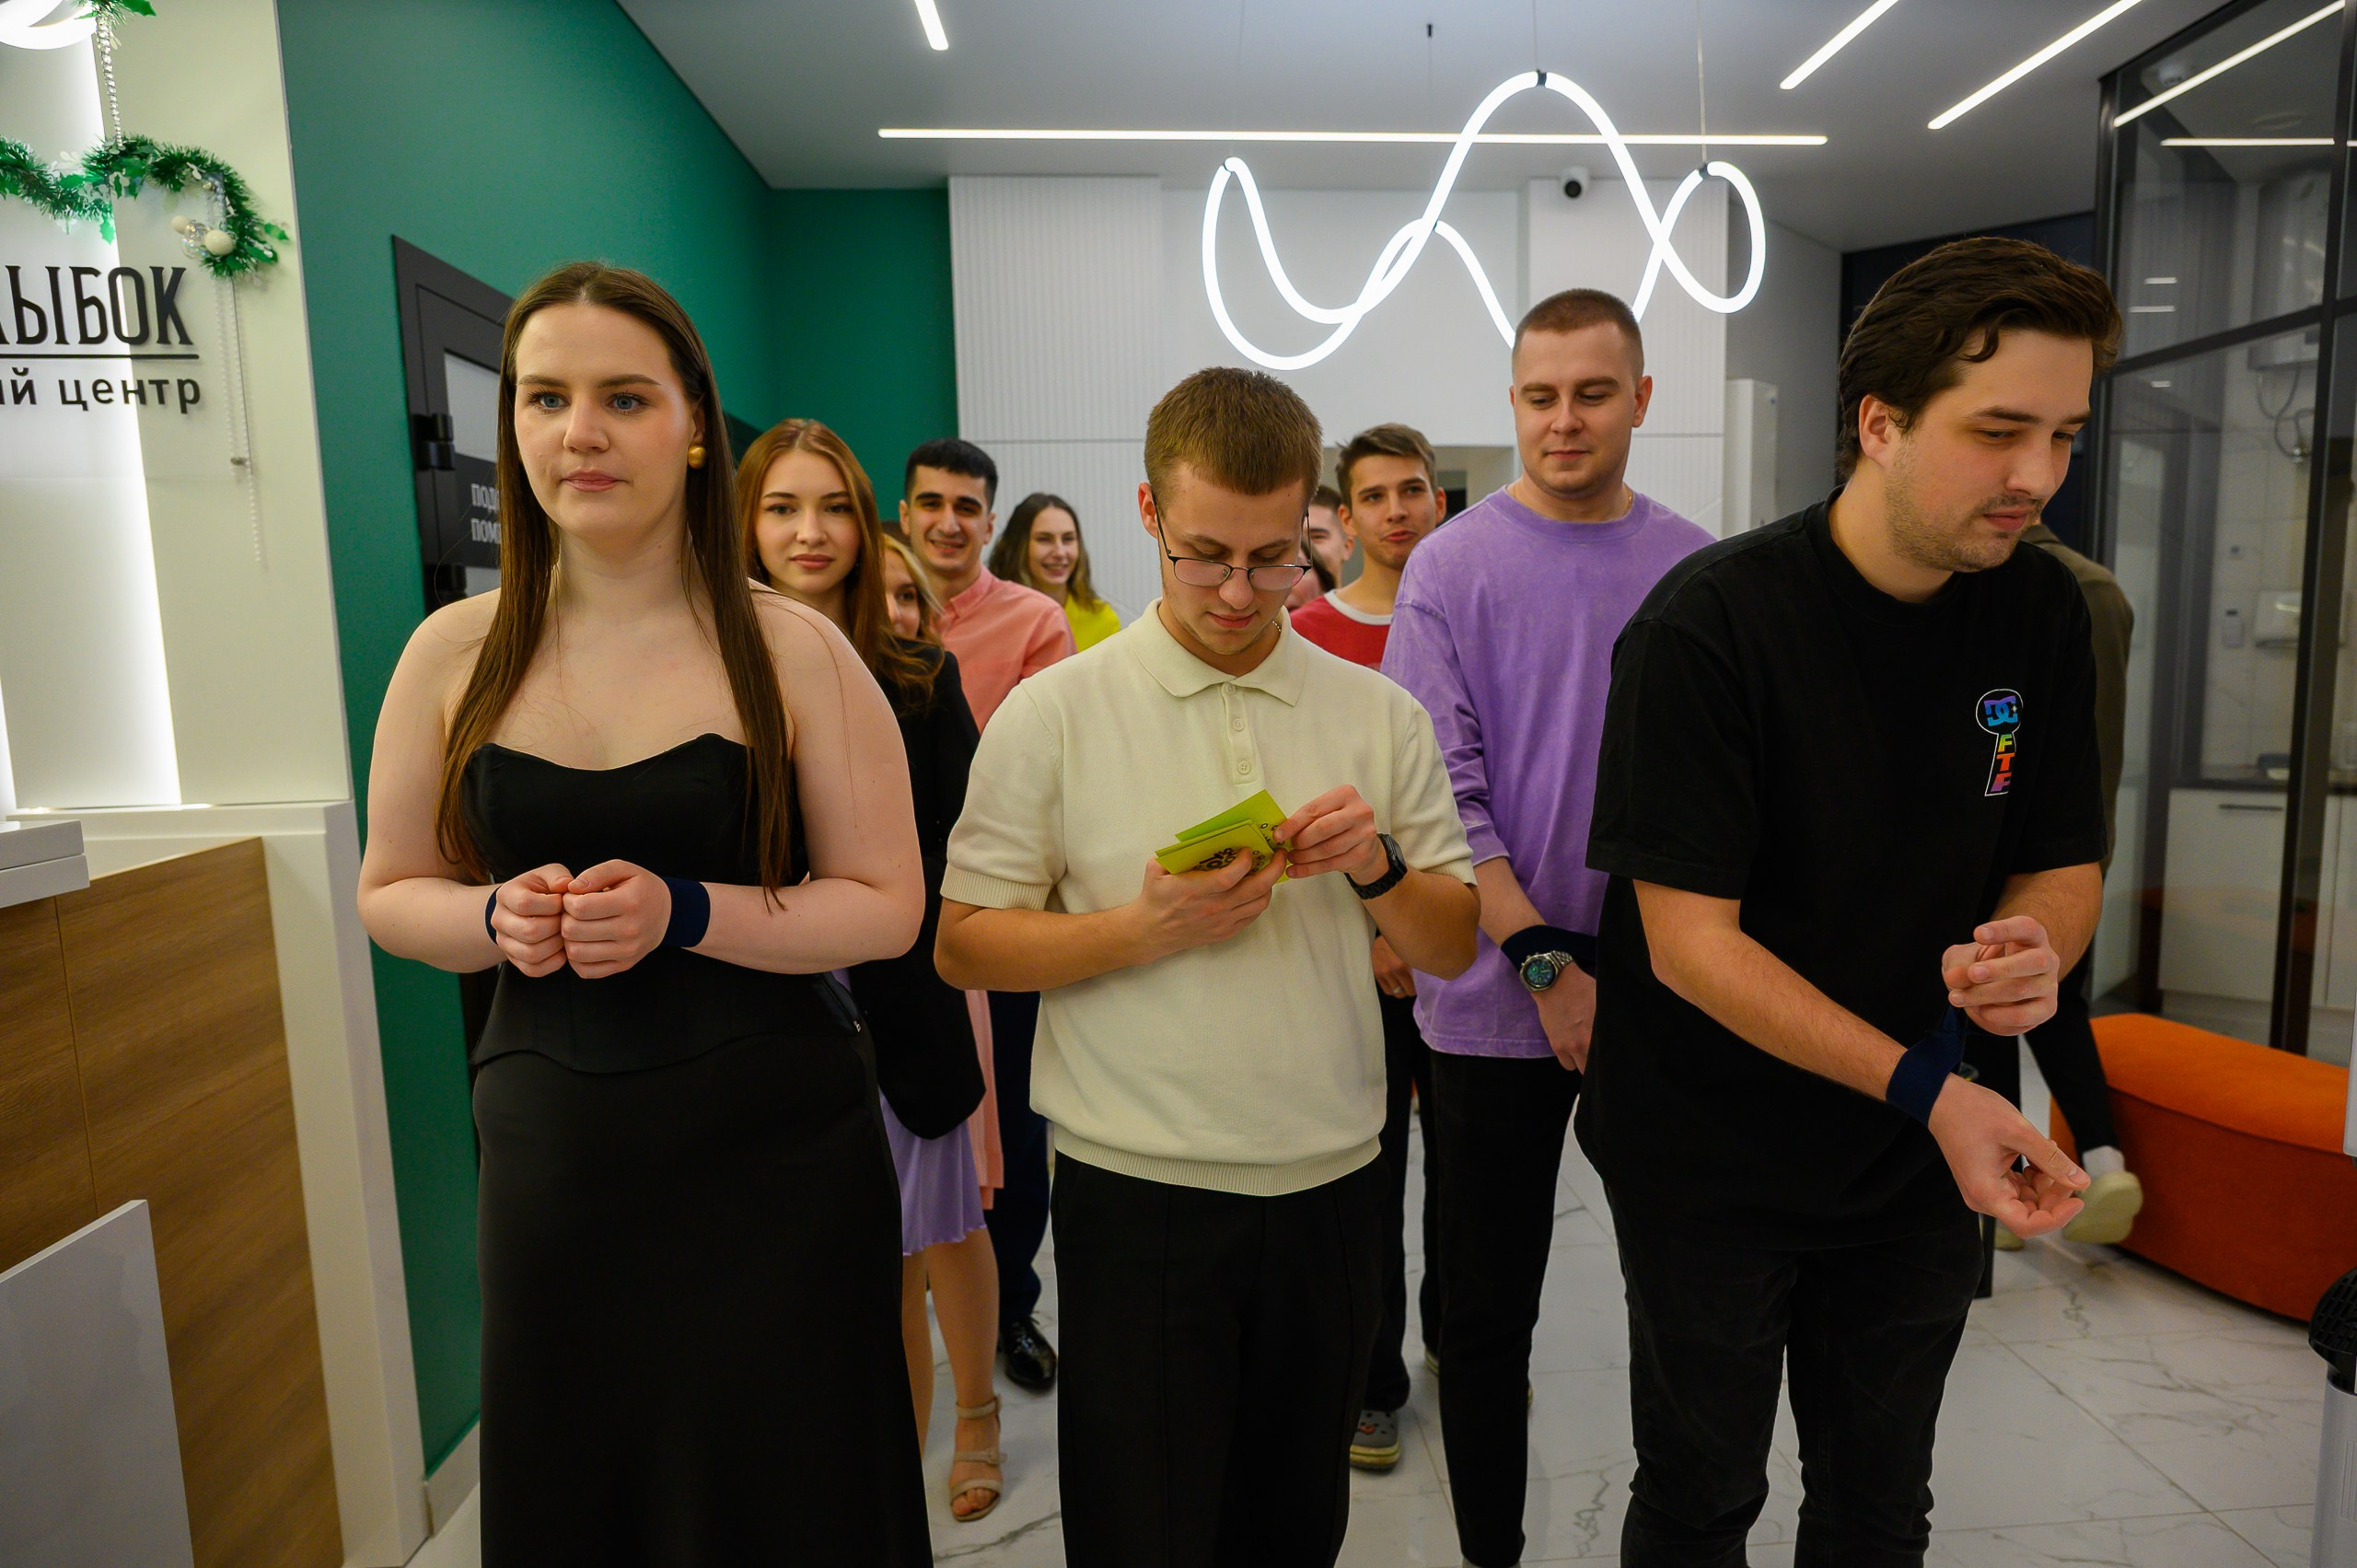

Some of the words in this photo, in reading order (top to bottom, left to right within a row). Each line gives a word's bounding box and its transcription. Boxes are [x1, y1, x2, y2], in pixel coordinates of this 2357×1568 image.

[0, 366, 37, 405] й
[58, 378, 201, 414] центр
[1984, 695, 2018, 726] DC
